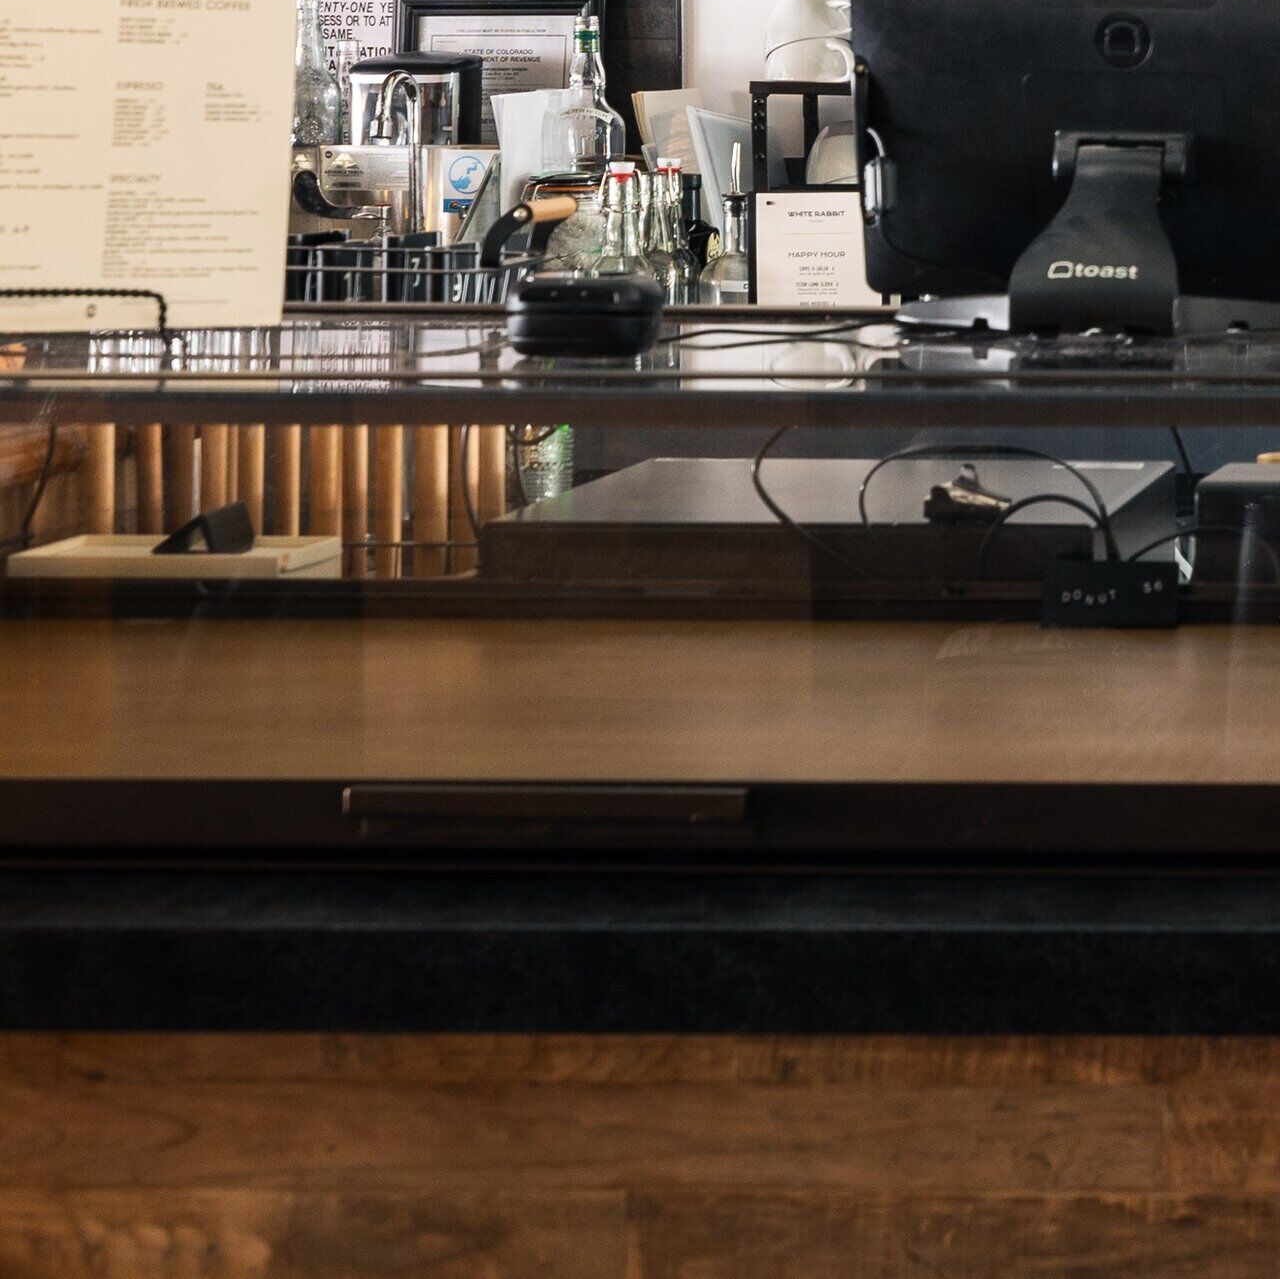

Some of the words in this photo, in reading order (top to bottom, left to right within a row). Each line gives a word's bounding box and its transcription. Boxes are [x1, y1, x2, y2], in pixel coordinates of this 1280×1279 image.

[345, 15, 360, 26] OR
[364, 15, 376, 26] TO
[322, 29, 356, 40] SAME.
[1074, 263, 1139, 281] toast
[1062, 589, 1117, 606] DONUT
[1143, 580, 1163, 595] $6
